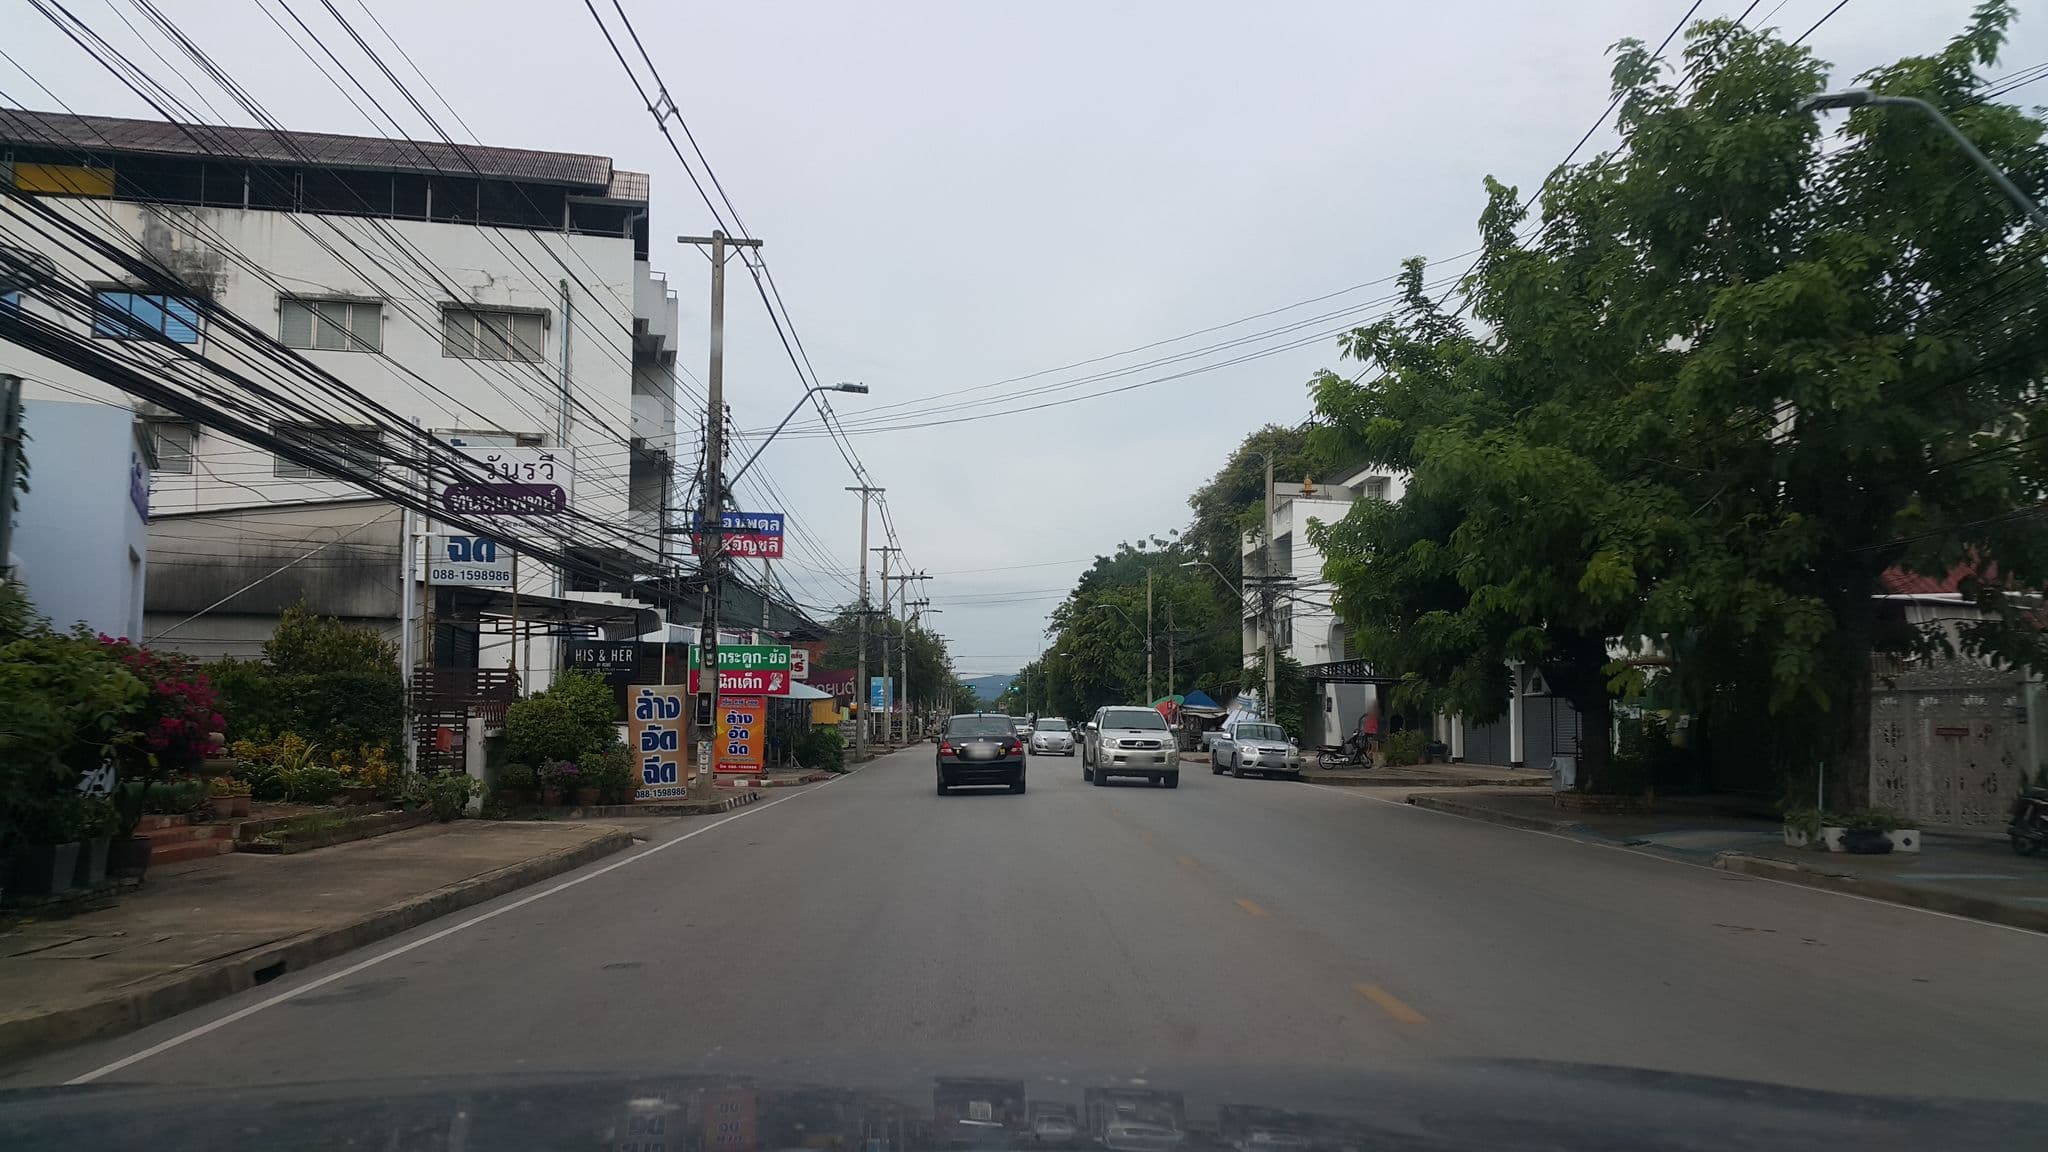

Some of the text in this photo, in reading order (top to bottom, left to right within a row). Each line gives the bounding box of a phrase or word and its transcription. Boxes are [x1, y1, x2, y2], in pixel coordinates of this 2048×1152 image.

[484, 453, 554, 480] วันรวี
[432, 569, 510, 581] 088-1598986
[575, 649, 633, 662] HIS & HER
[695, 647, 787, 669] โกระดูก-ข้อ
[697, 672, 762, 689] นิกเด็ก
[636, 689, 681, 720] ล้าง
[726, 709, 753, 724] ล้าง
[641, 724, 677, 752] อัด
[728, 726, 749, 739] อัด
[643, 756, 676, 784] ฉีด
